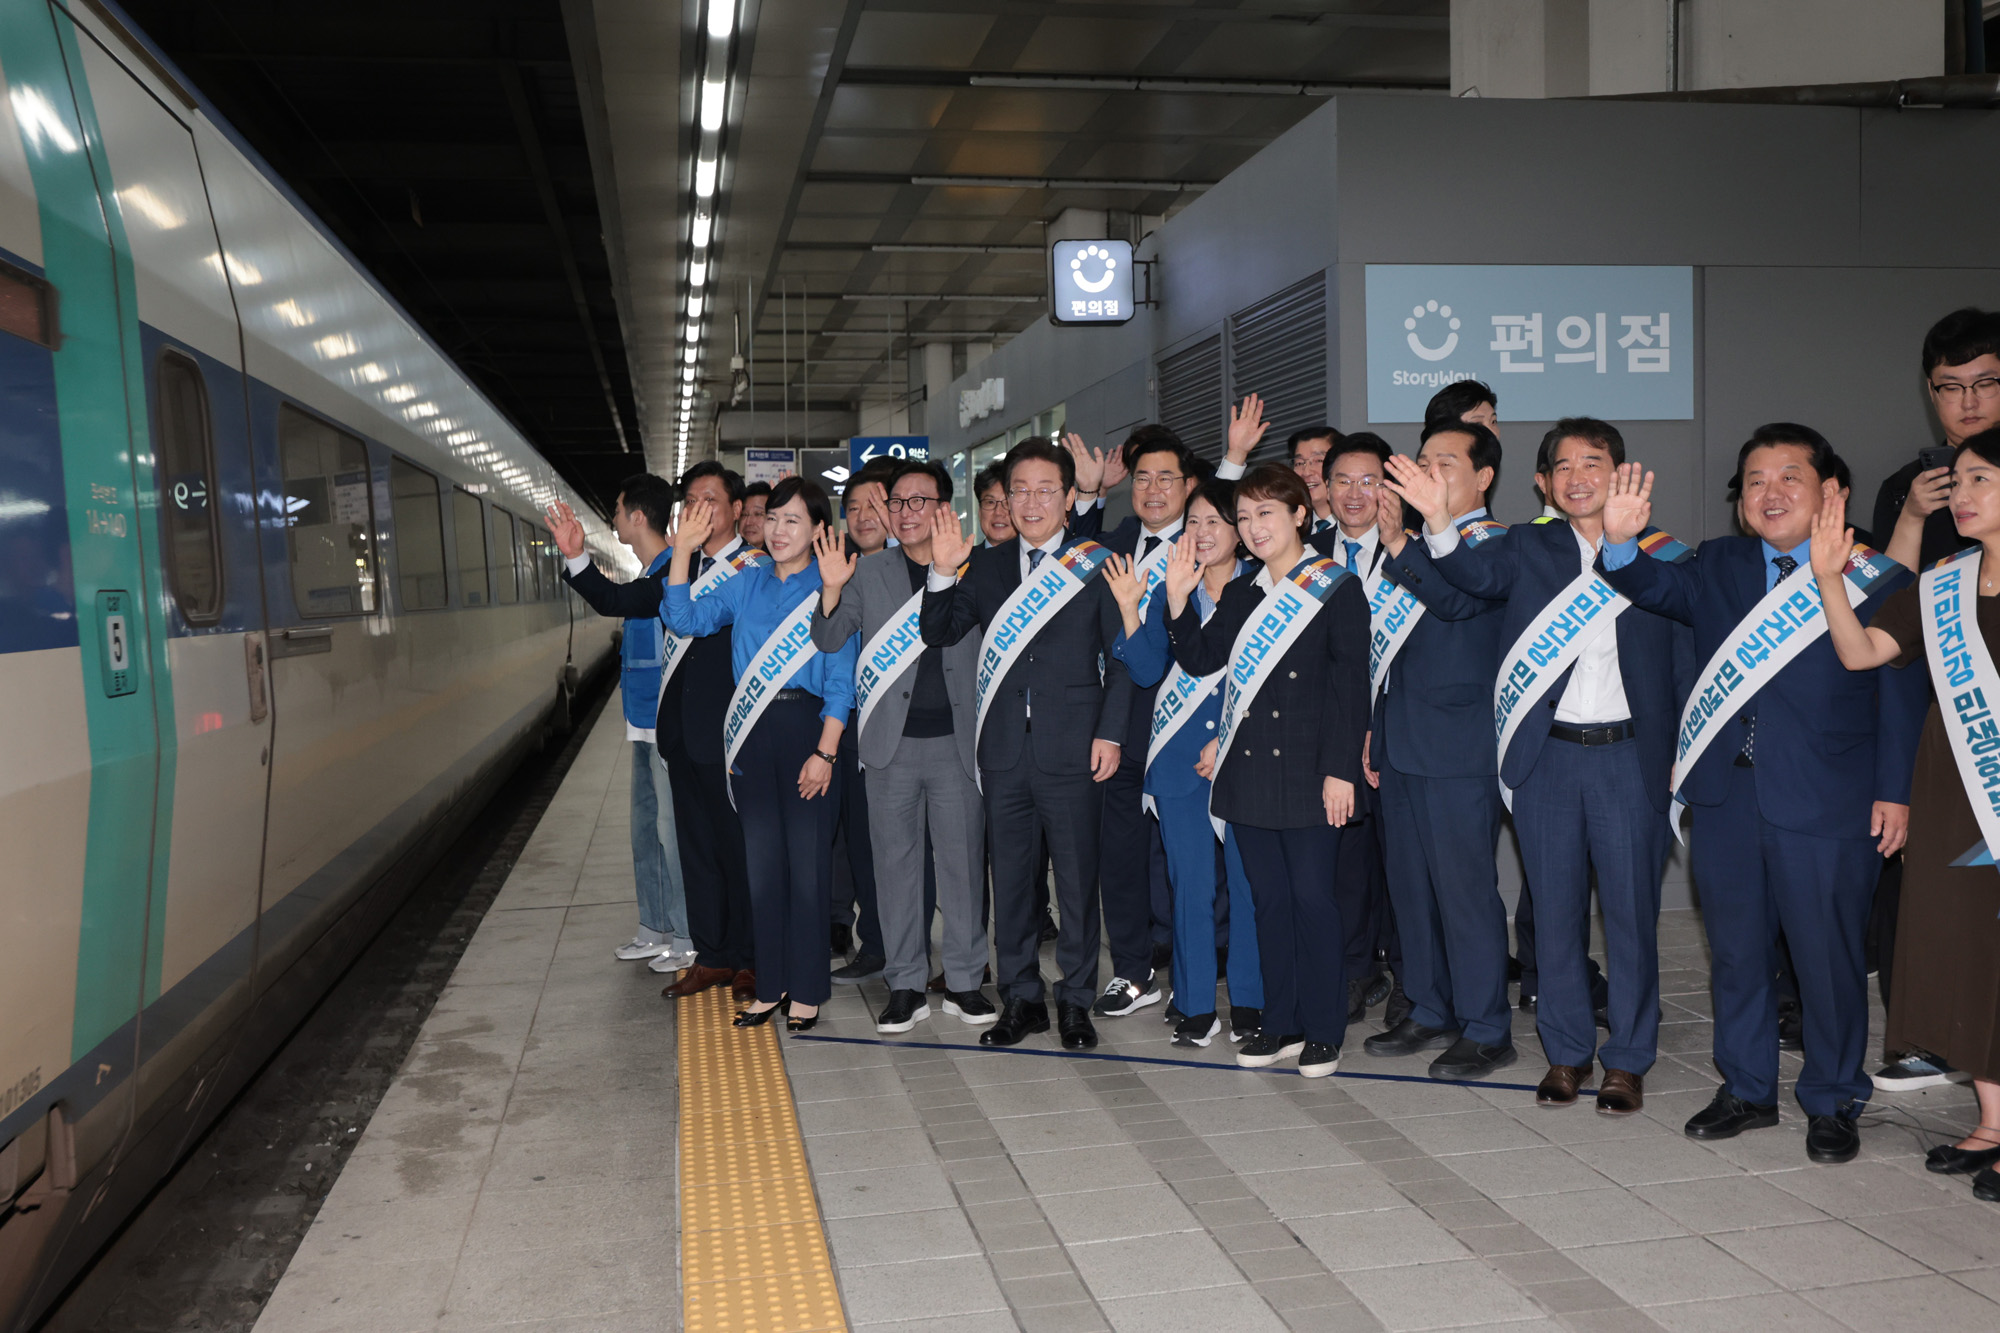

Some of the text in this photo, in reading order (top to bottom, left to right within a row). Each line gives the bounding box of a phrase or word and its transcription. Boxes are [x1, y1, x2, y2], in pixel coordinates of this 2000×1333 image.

[1071, 300, 1119, 316] 편의점
[1490, 312, 1670, 374] 편의점
[1066, 547, 1095, 571] 민주당
[1301, 564, 1333, 588] 민주당
[113, 622, 123, 662] 5
[994, 570, 1067, 652] 국민건강
[1233, 592, 1304, 685] 국민건강
[1933, 567, 1975, 688] 국민건강
[1678, 658, 1745, 762] 민생회복
